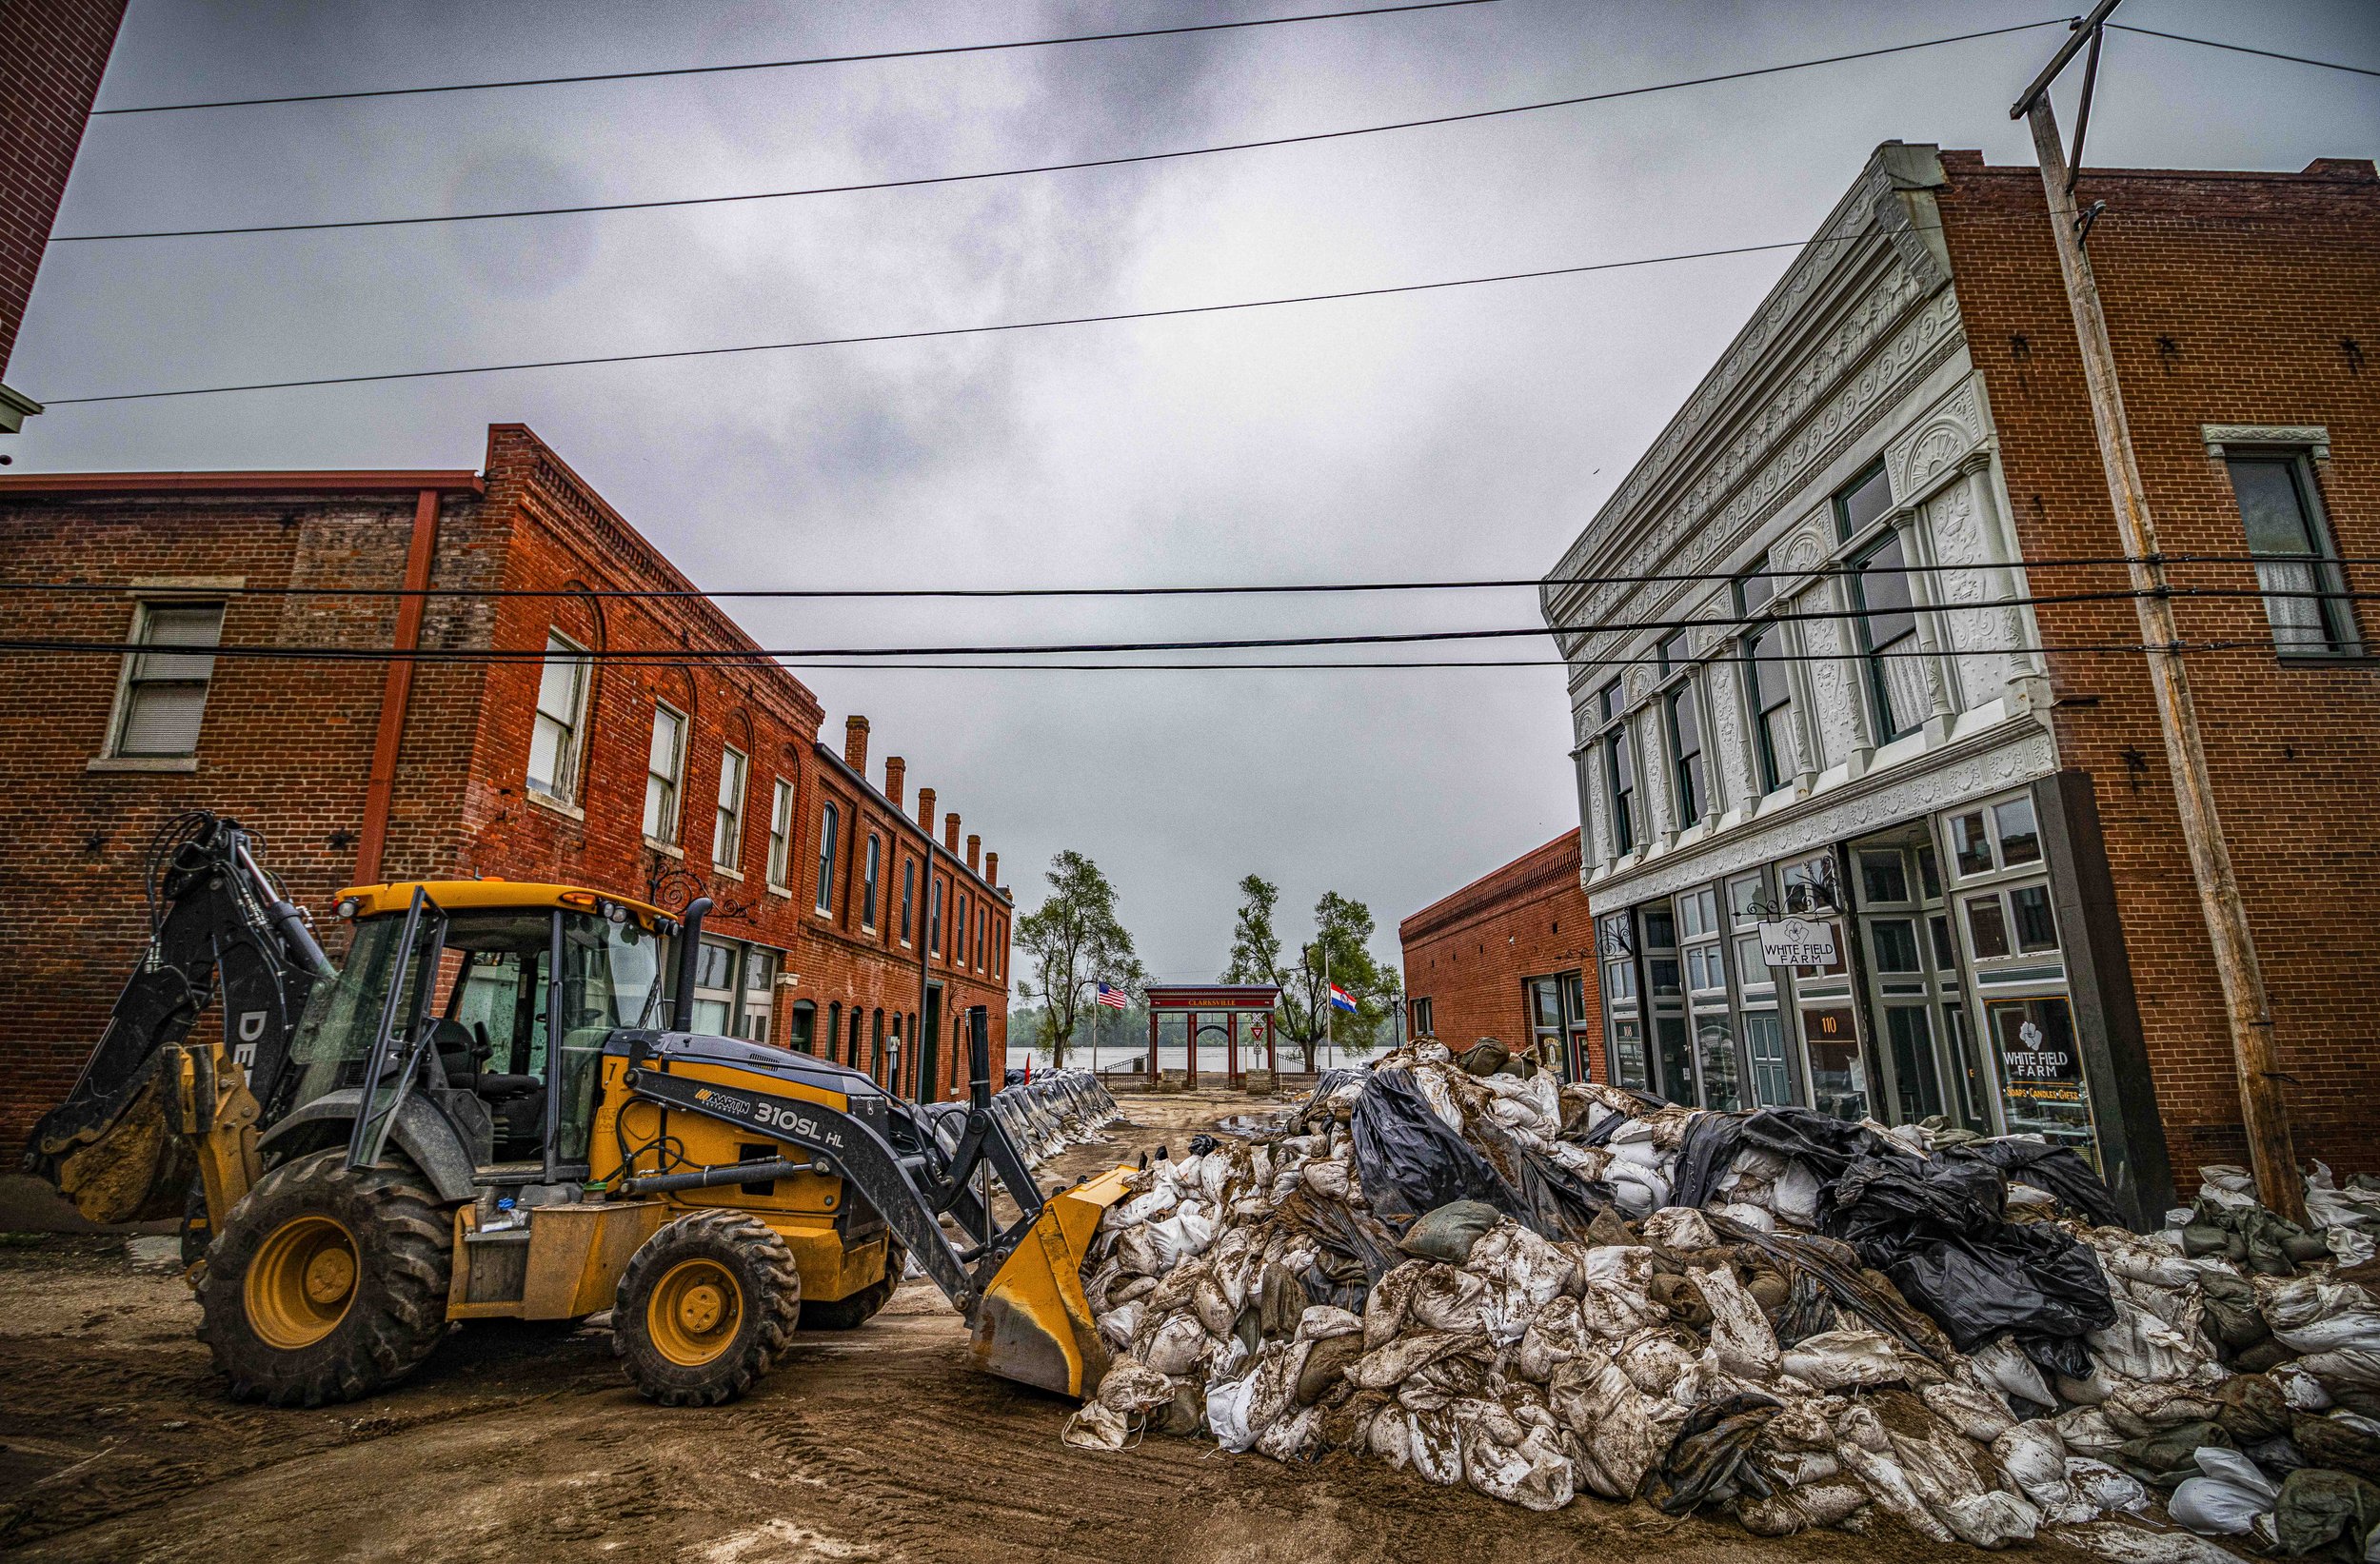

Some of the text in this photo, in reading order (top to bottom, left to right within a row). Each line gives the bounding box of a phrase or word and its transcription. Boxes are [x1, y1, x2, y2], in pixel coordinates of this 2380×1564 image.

[1764, 943, 1834, 956] WHITE FIELD
[1780, 955, 1822, 964] FARM
[1821, 1016, 1837, 1033] 110
[2003, 1052, 2068, 1065] WHITE FIELD
[2017, 1065, 2057, 1078] FARM
[706, 1092, 750, 1114] MARTIN
[754, 1102, 822, 1140] 310SL
[825, 1132, 844, 1148] HL
